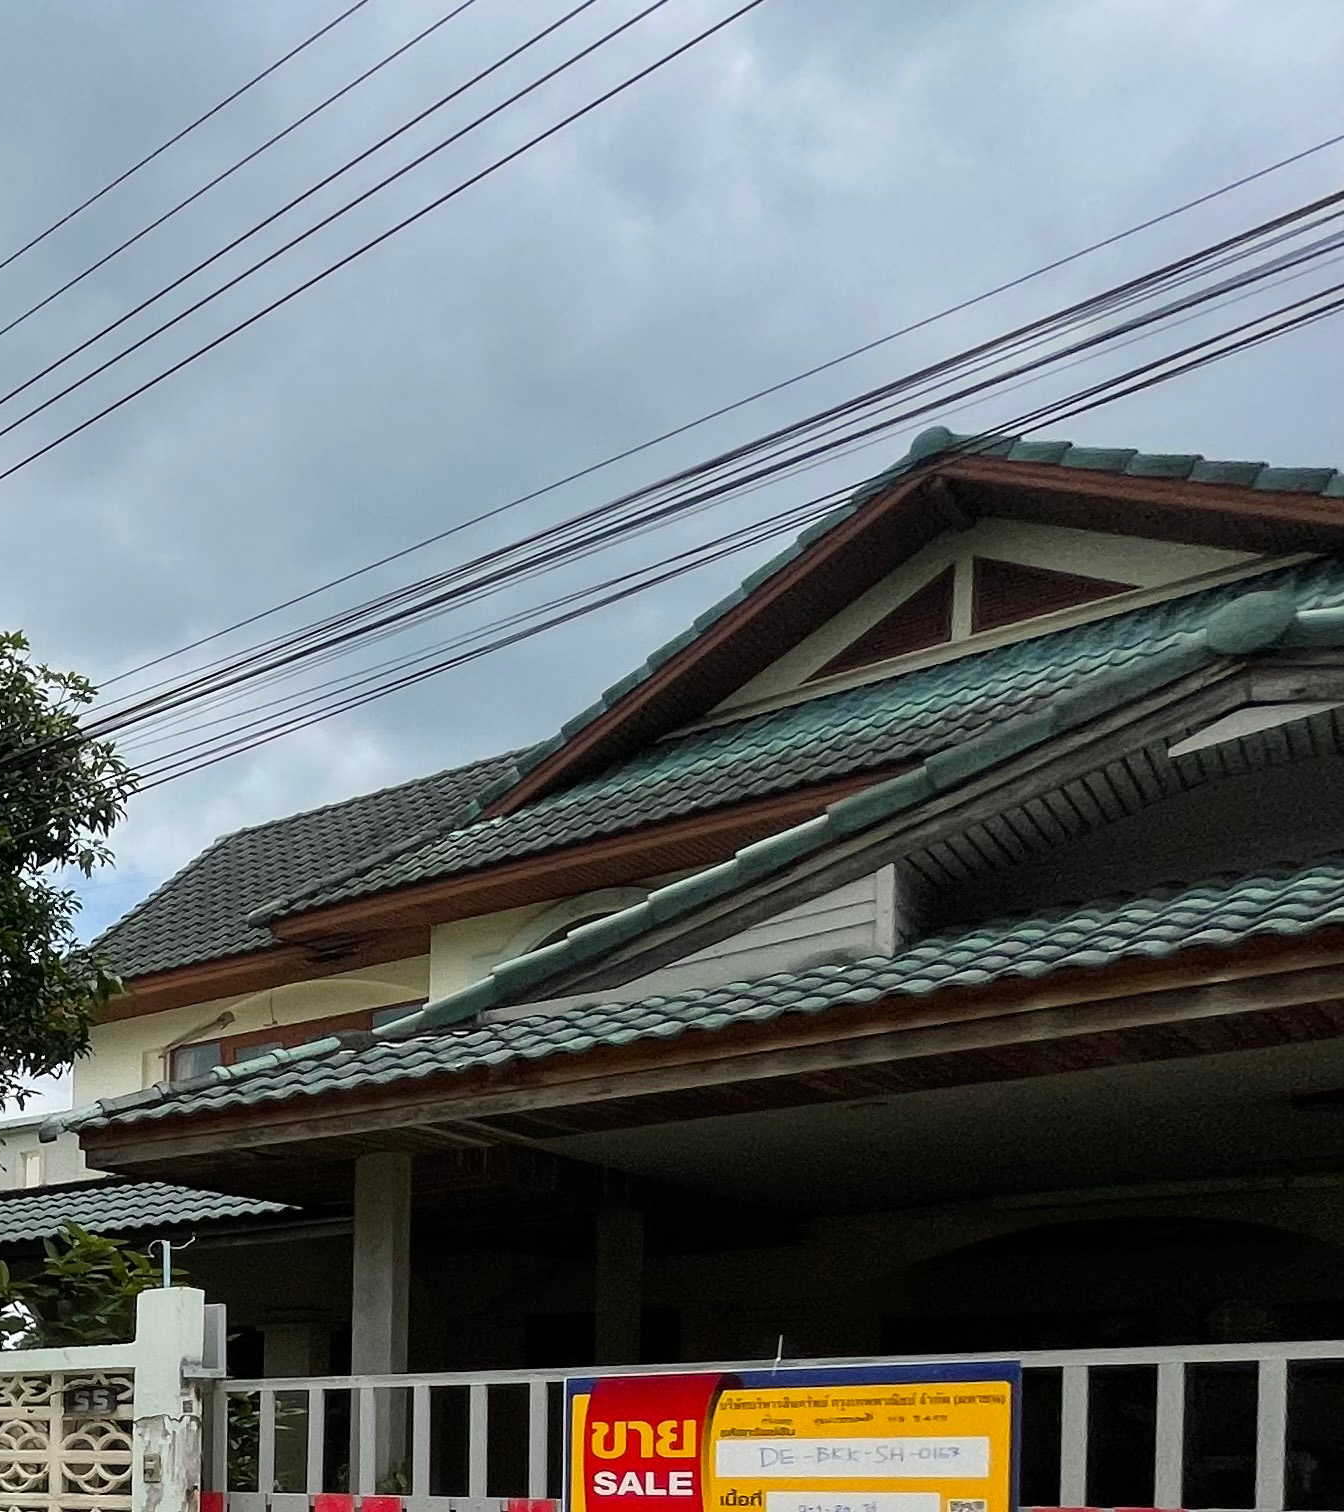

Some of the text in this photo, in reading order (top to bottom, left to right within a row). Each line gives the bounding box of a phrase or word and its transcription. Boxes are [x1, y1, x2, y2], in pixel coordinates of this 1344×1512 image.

[73, 1389, 110, 1411] 55
[592, 1419, 697, 1459] ขาย
[593, 1471, 694, 1496] SALE
[720, 1488, 762, 1507] เนื้อที่
